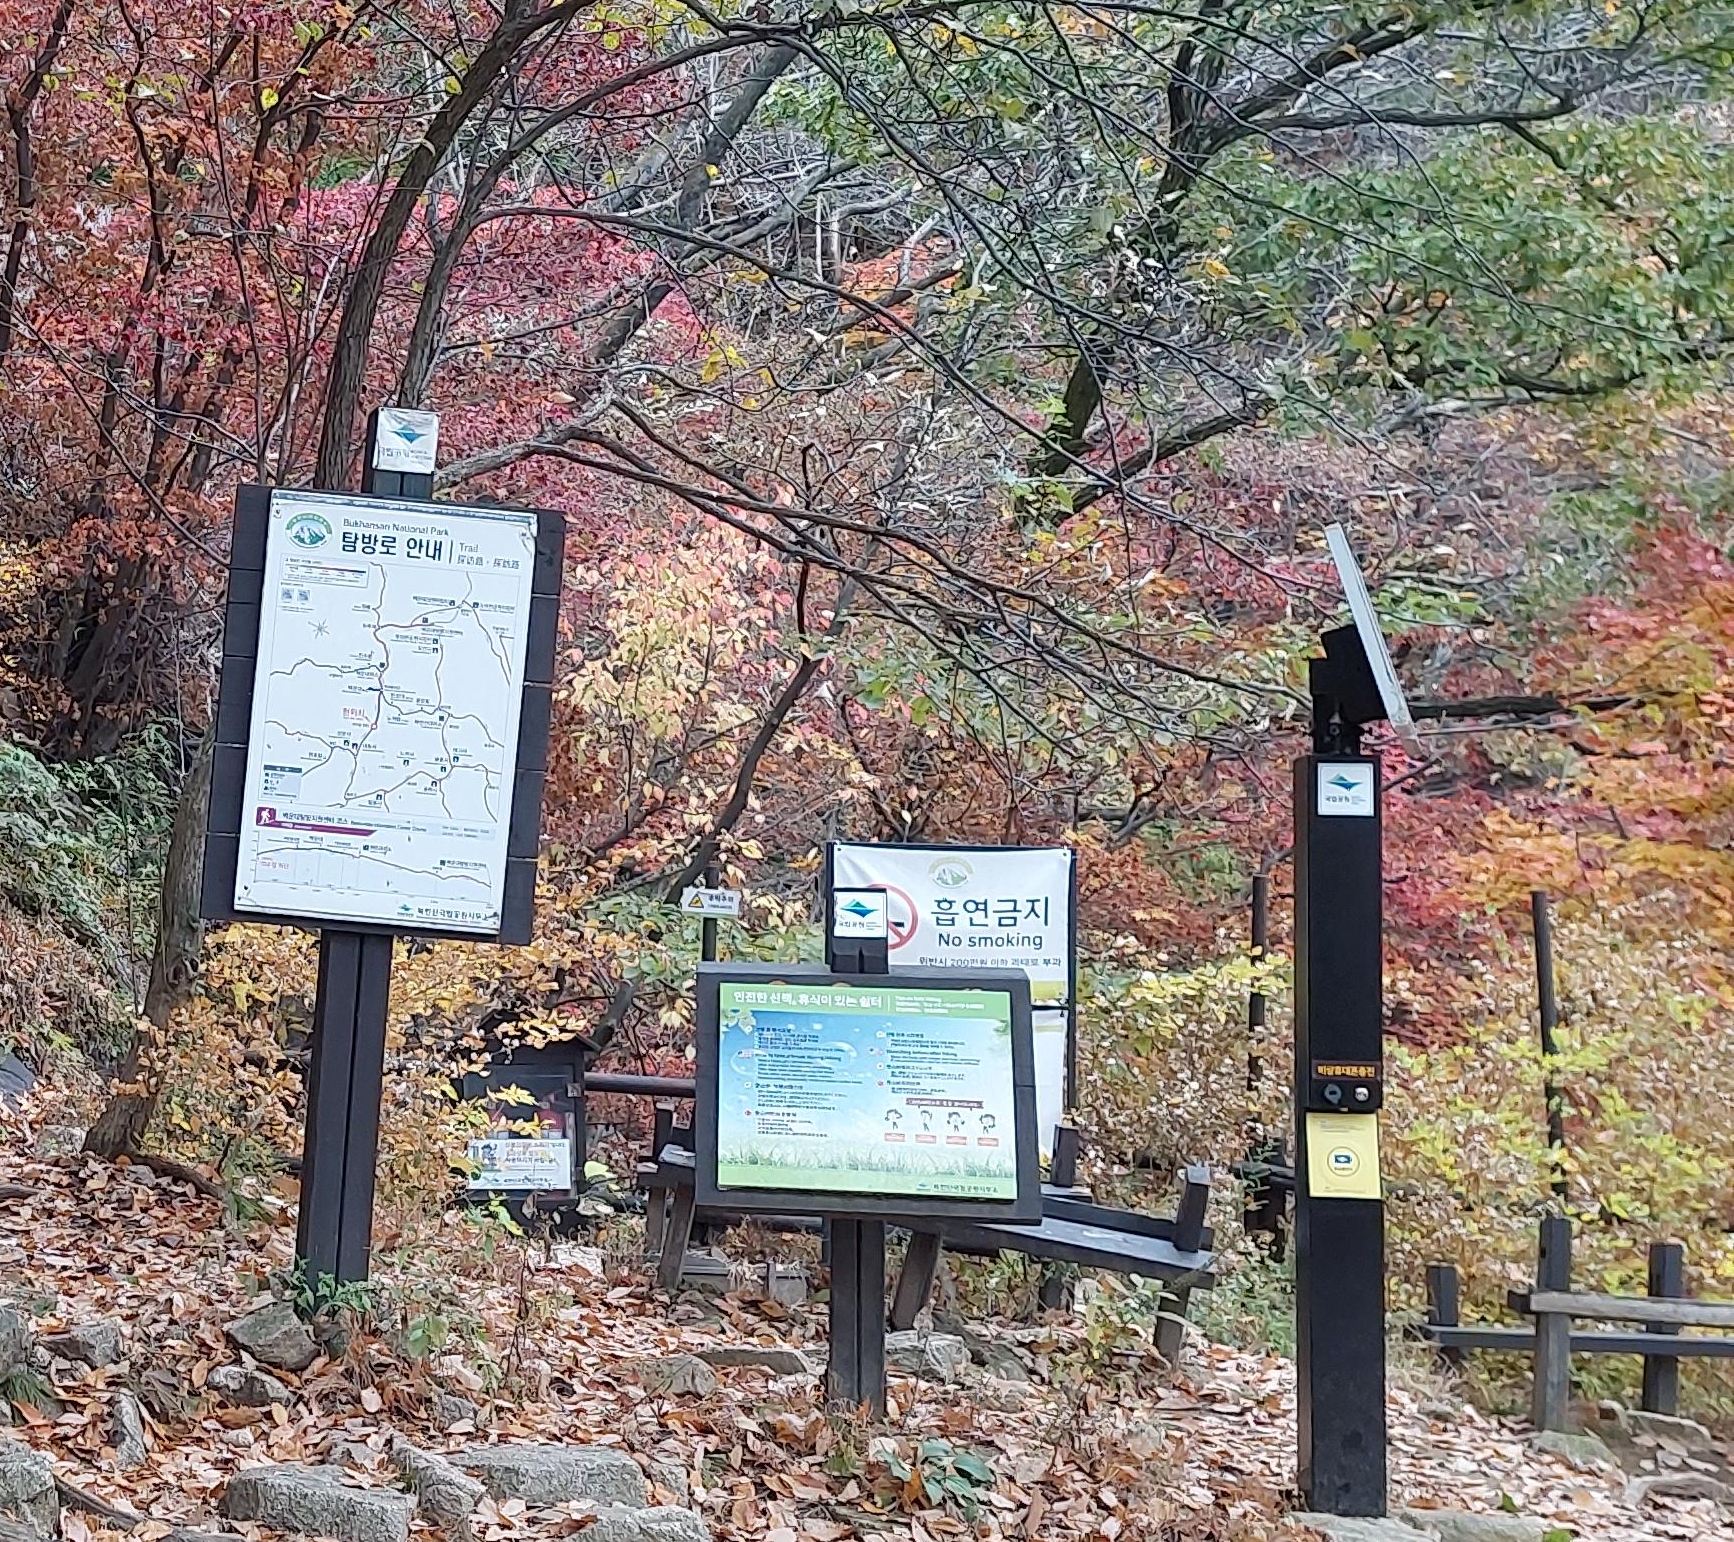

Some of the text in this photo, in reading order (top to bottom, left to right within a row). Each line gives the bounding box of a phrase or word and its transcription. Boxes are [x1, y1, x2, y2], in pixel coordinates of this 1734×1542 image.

[343, 518, 391, 532] Bukhansan
[392, 521, 429, 535] National
[431, 525, 449, 536] Park
[342, 531, 443, 561] 탐방로 안내
[931, 896, 1049, 927] 흡연금지
[938, 933, 1043, 950] No smoking
